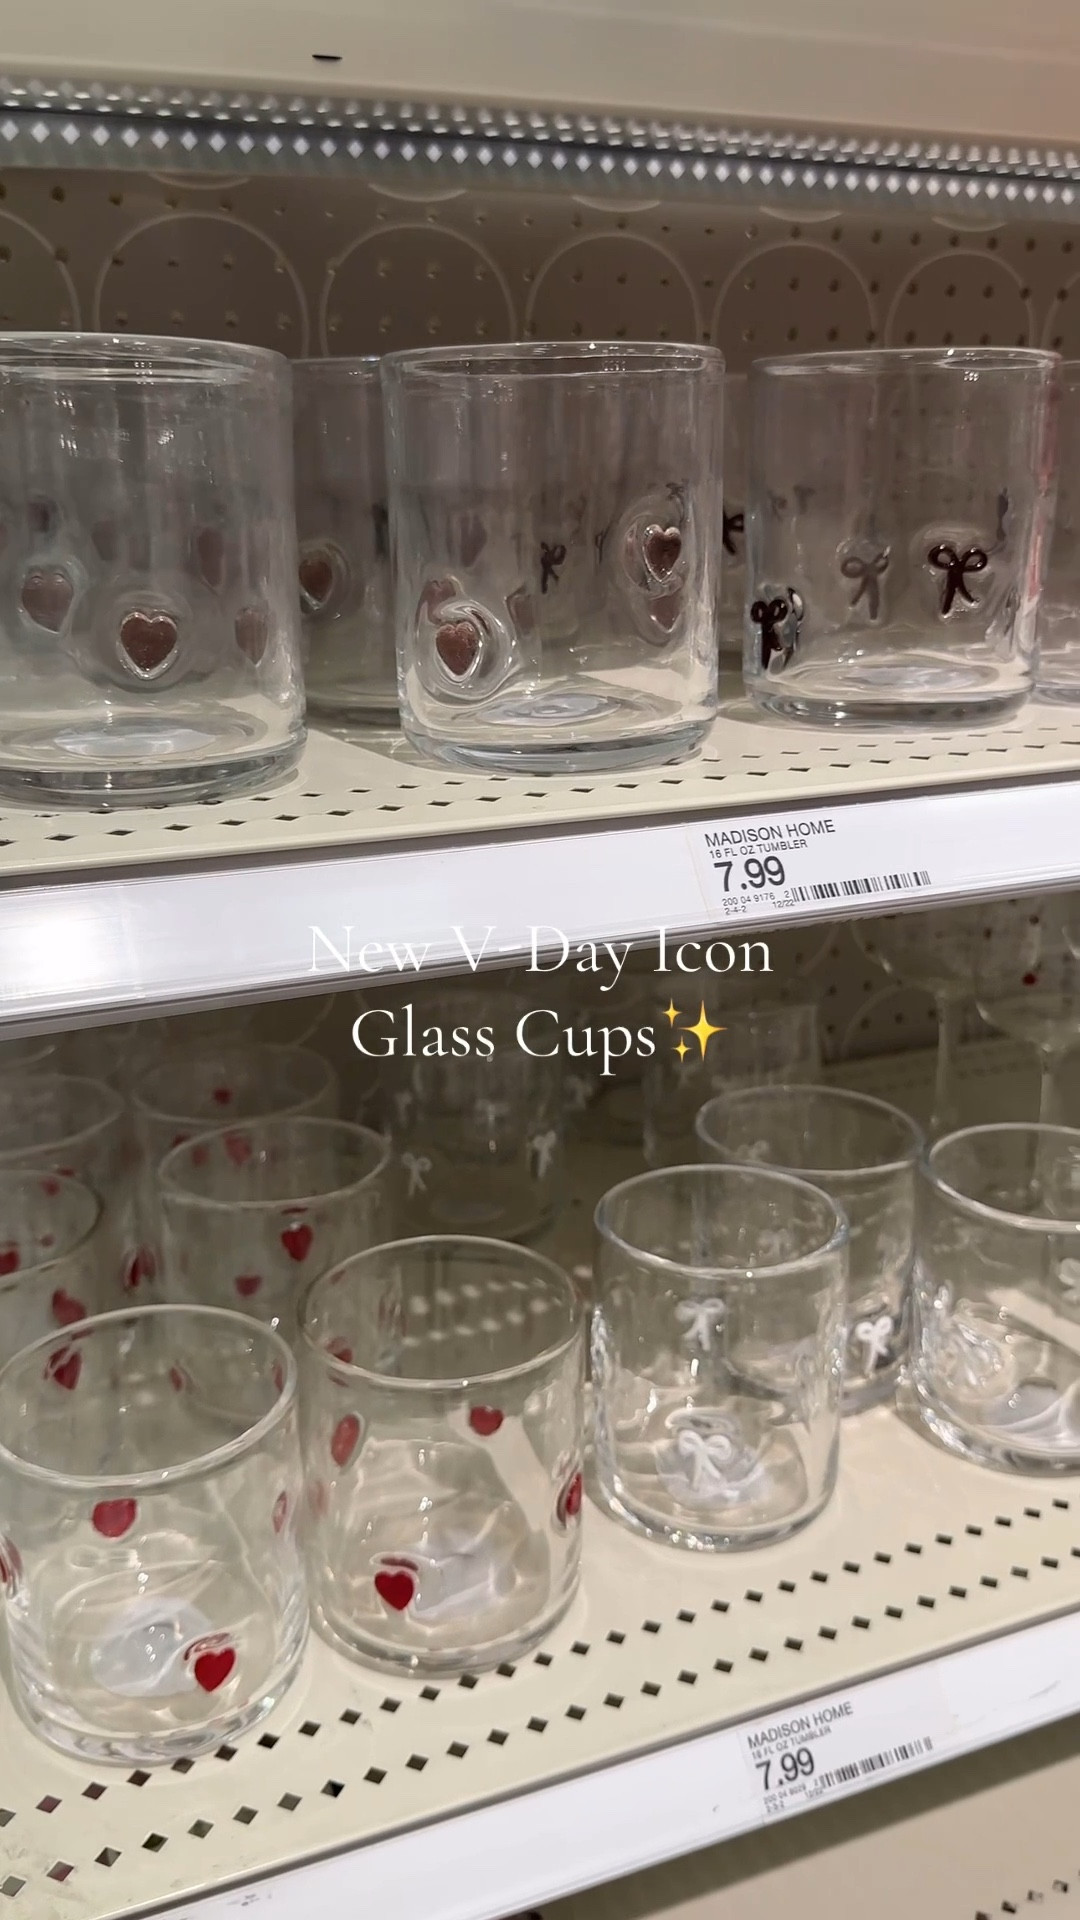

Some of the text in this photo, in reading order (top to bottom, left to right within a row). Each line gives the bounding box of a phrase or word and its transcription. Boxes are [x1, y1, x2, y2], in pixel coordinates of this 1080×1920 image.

[705, 820, 835, 847] MADISON HOME
[709, 839, 808, 859] 16 FL OZ TUMBLER
[714, 856, 785, 892] 7.99
[722, 897, 738, 906] 200
[741, 896, 752, 904] 04
[753, 892, 775, 902] 9176
[747, 1701, 854, 1749] MADISON HOME
[756, 1747, 815, 1790] 7.99
